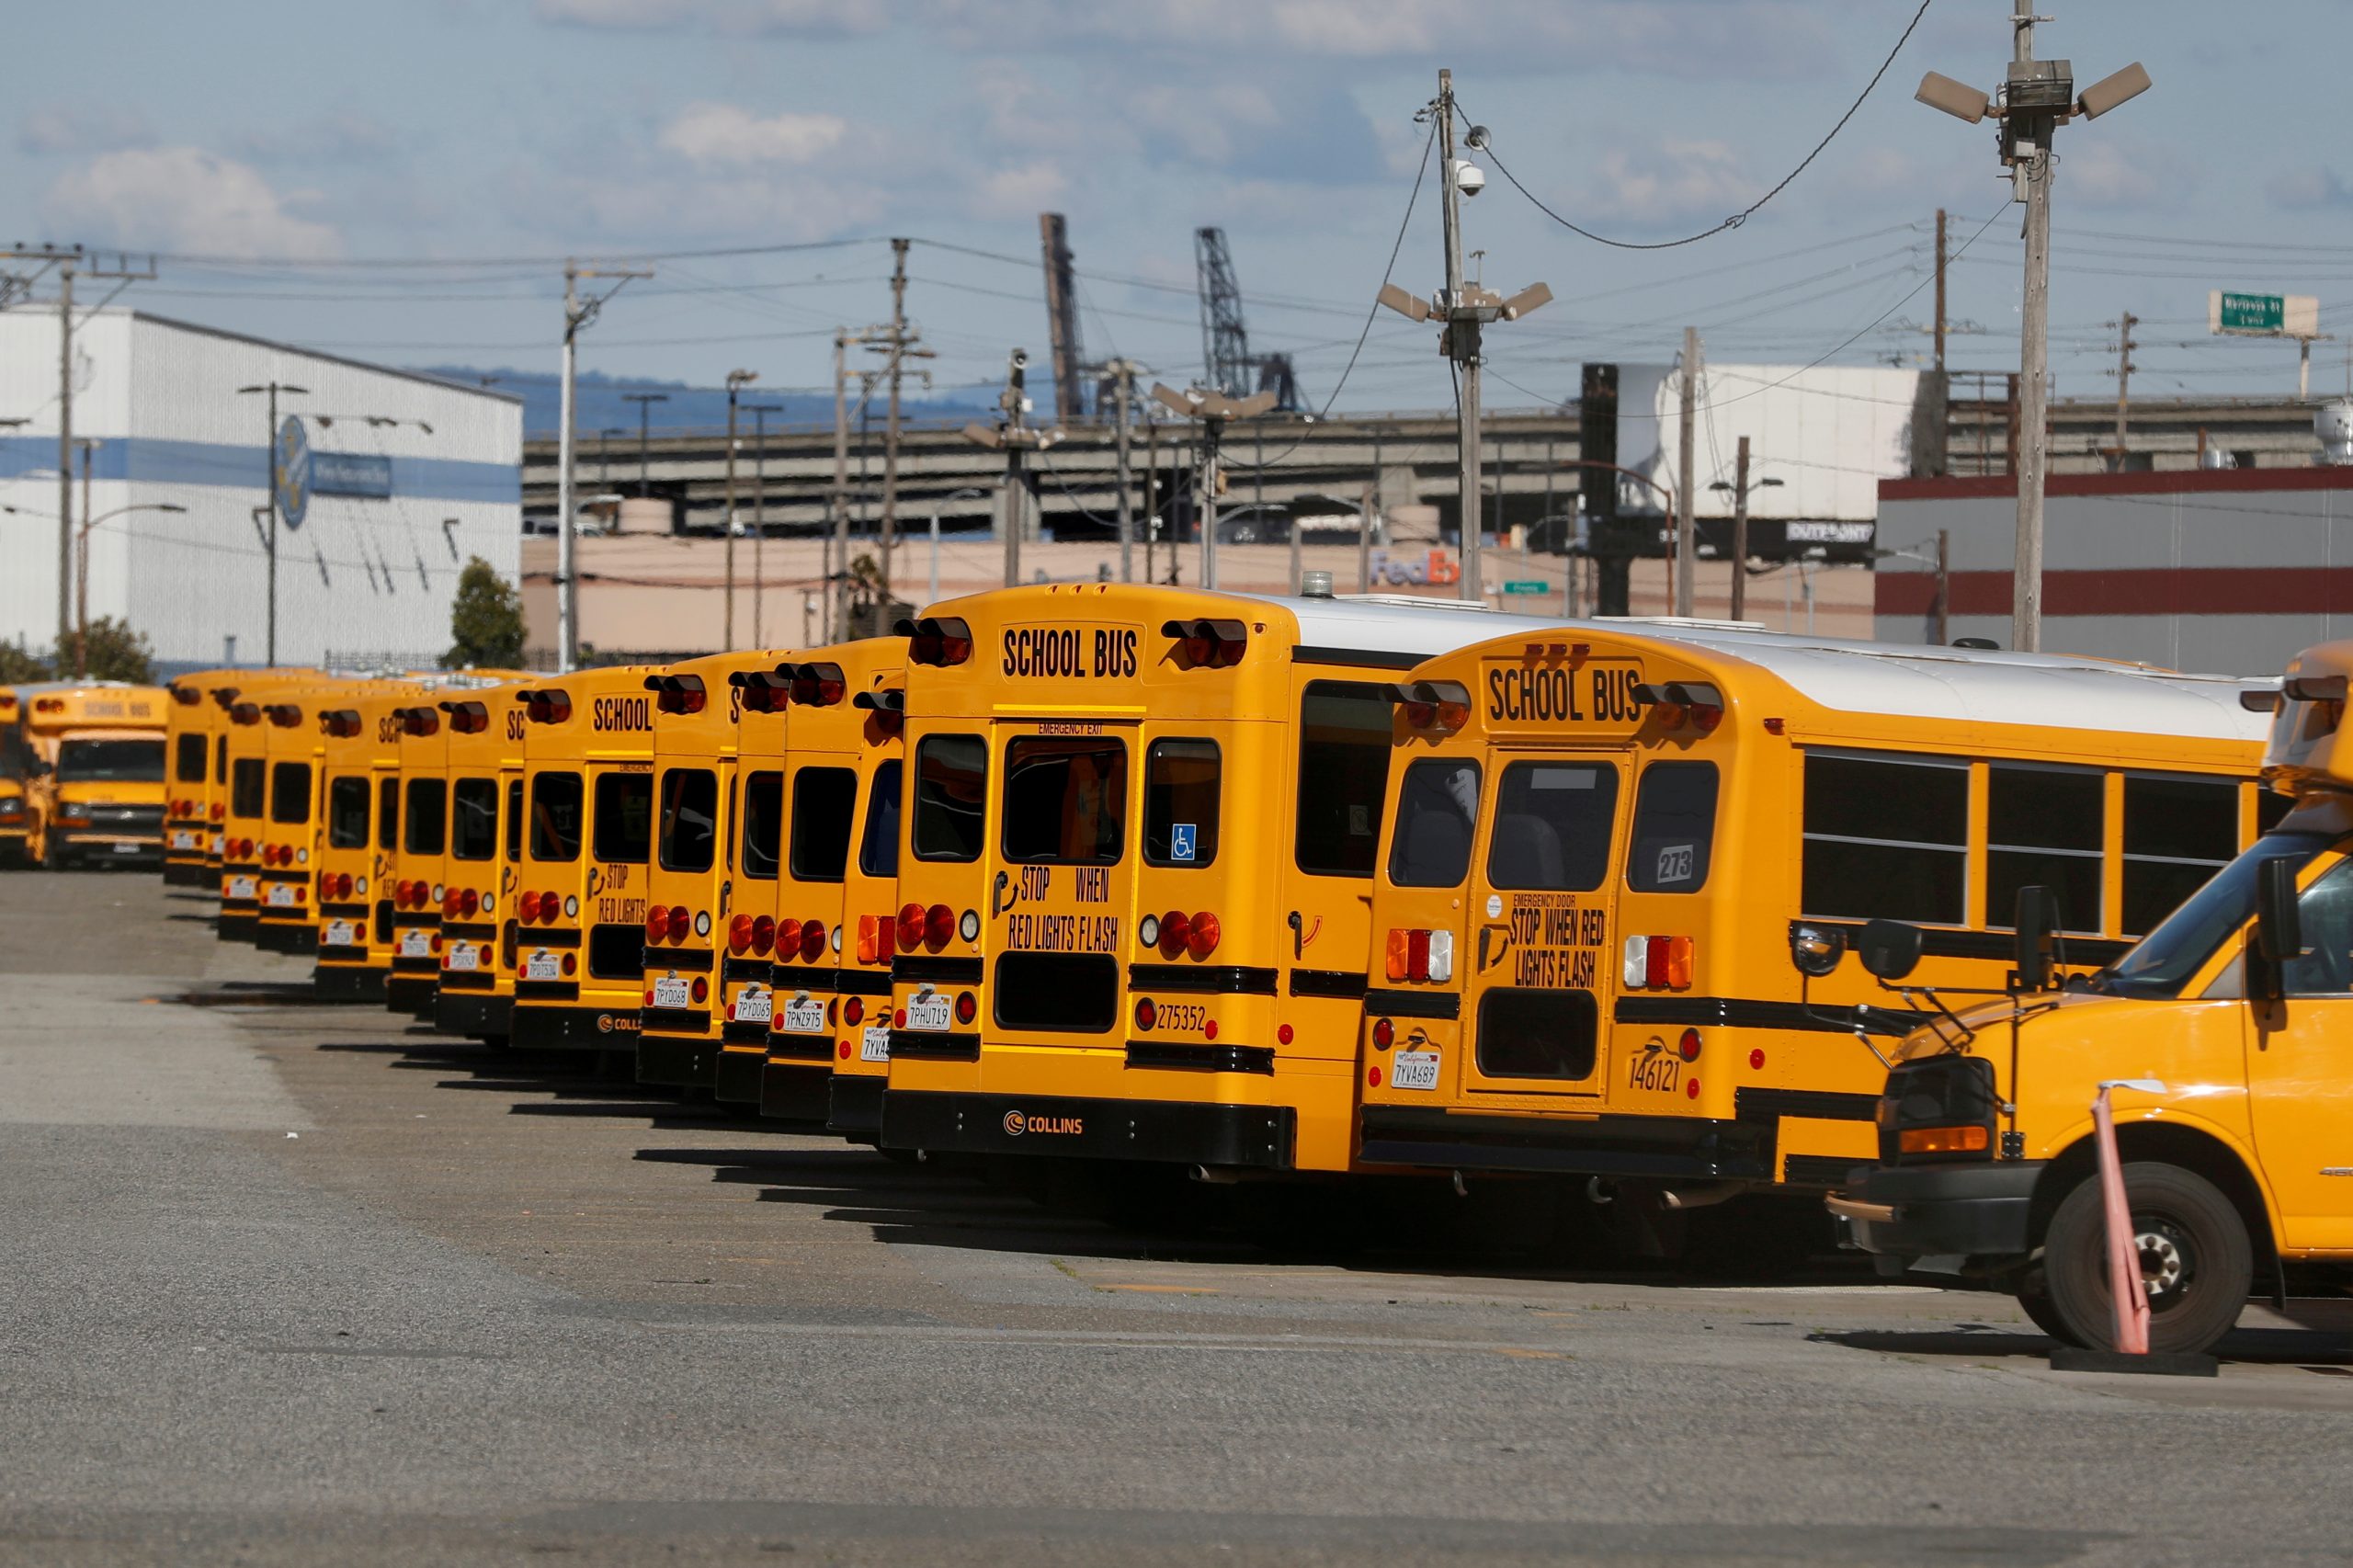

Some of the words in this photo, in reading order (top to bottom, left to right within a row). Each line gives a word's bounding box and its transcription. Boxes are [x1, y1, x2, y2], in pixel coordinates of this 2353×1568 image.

[1004, 629, 1086, 677] SCHOOL
[1094, 630, 1137, 678] BUS
[1489, 668, 1584, 722] SCHOOL
[1592, 669, 1642, 722] BUS
[594, 698, 653, 732] SCHOOL
[1039, 722, 1084, 734] EMERGENCY
[1087, 722, 1103, 735] EXIT
[607, 864, 628, 890] STOP
[1660, 850, 1692, 879] 273
[1021, 865, 1050, 901] STOP
[1075, 867, 1109, 903] WHEN
[599, 897, 616, 923] RED
[618, 898, 646, 924] LIGHTS
[1514, 894, 1555, 907] EMERGENCY
[1556, 895, 1575, 907] DOOR
[1008, 914, 1032, 949] RED
[1035, 914, 1075, 950] LIGHTS
[1078, 915, 1119, 952] FLASH
[1510, 908, 1541, 945] STOP
[1545, 908, 1578, 946] WHEN
[1581, 909, 1605, 947] RED
[1516, 949, 1555, 988] LIGHTS
[1558, 950, 1597, 988] FLASH
[787, 1011, 821, 1028] 7PNZ975
[910, 1006, 948, 1026] 7PHU719
[1158, 1004, 1205, 1031] 275352
[865, 1039, 890, 1056] 7YVA
[1395, 1063, 1436, 1084] 7YVA689
[1630, 1057, 1680, 1092] 146121
[1028, 1116, 1083, 1135] COLLINS
